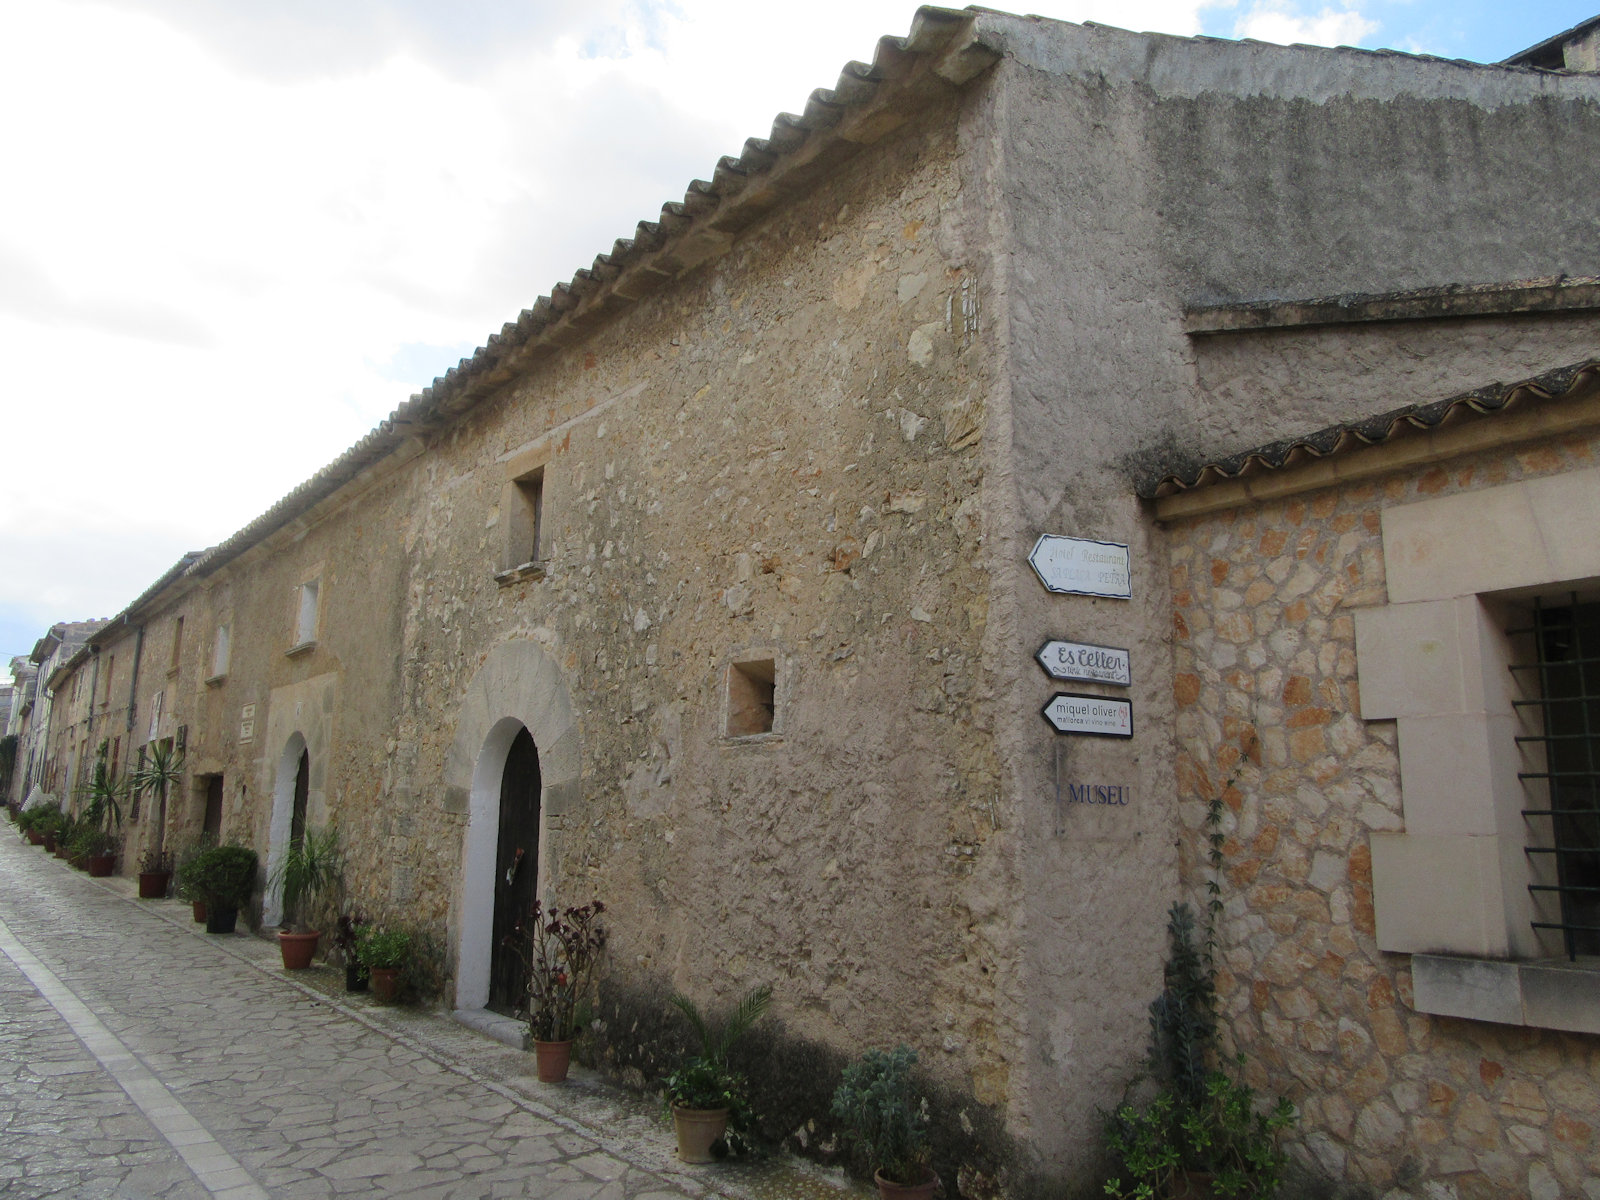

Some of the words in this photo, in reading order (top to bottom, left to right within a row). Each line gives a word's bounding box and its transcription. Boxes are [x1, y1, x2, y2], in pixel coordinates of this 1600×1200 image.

[1082, 549, 1125, 566] Restaurant
[1097, 571, 1126, 587] PETRA
[1078, 649, 1122, 670] Celler
[1056, 702, 1090, 717] miquel
[1092, 705, 1117, 717] oliver
[1056, 716, 1084, 724] mallorca
[1069, 783, 1130, 806] MUSEU
